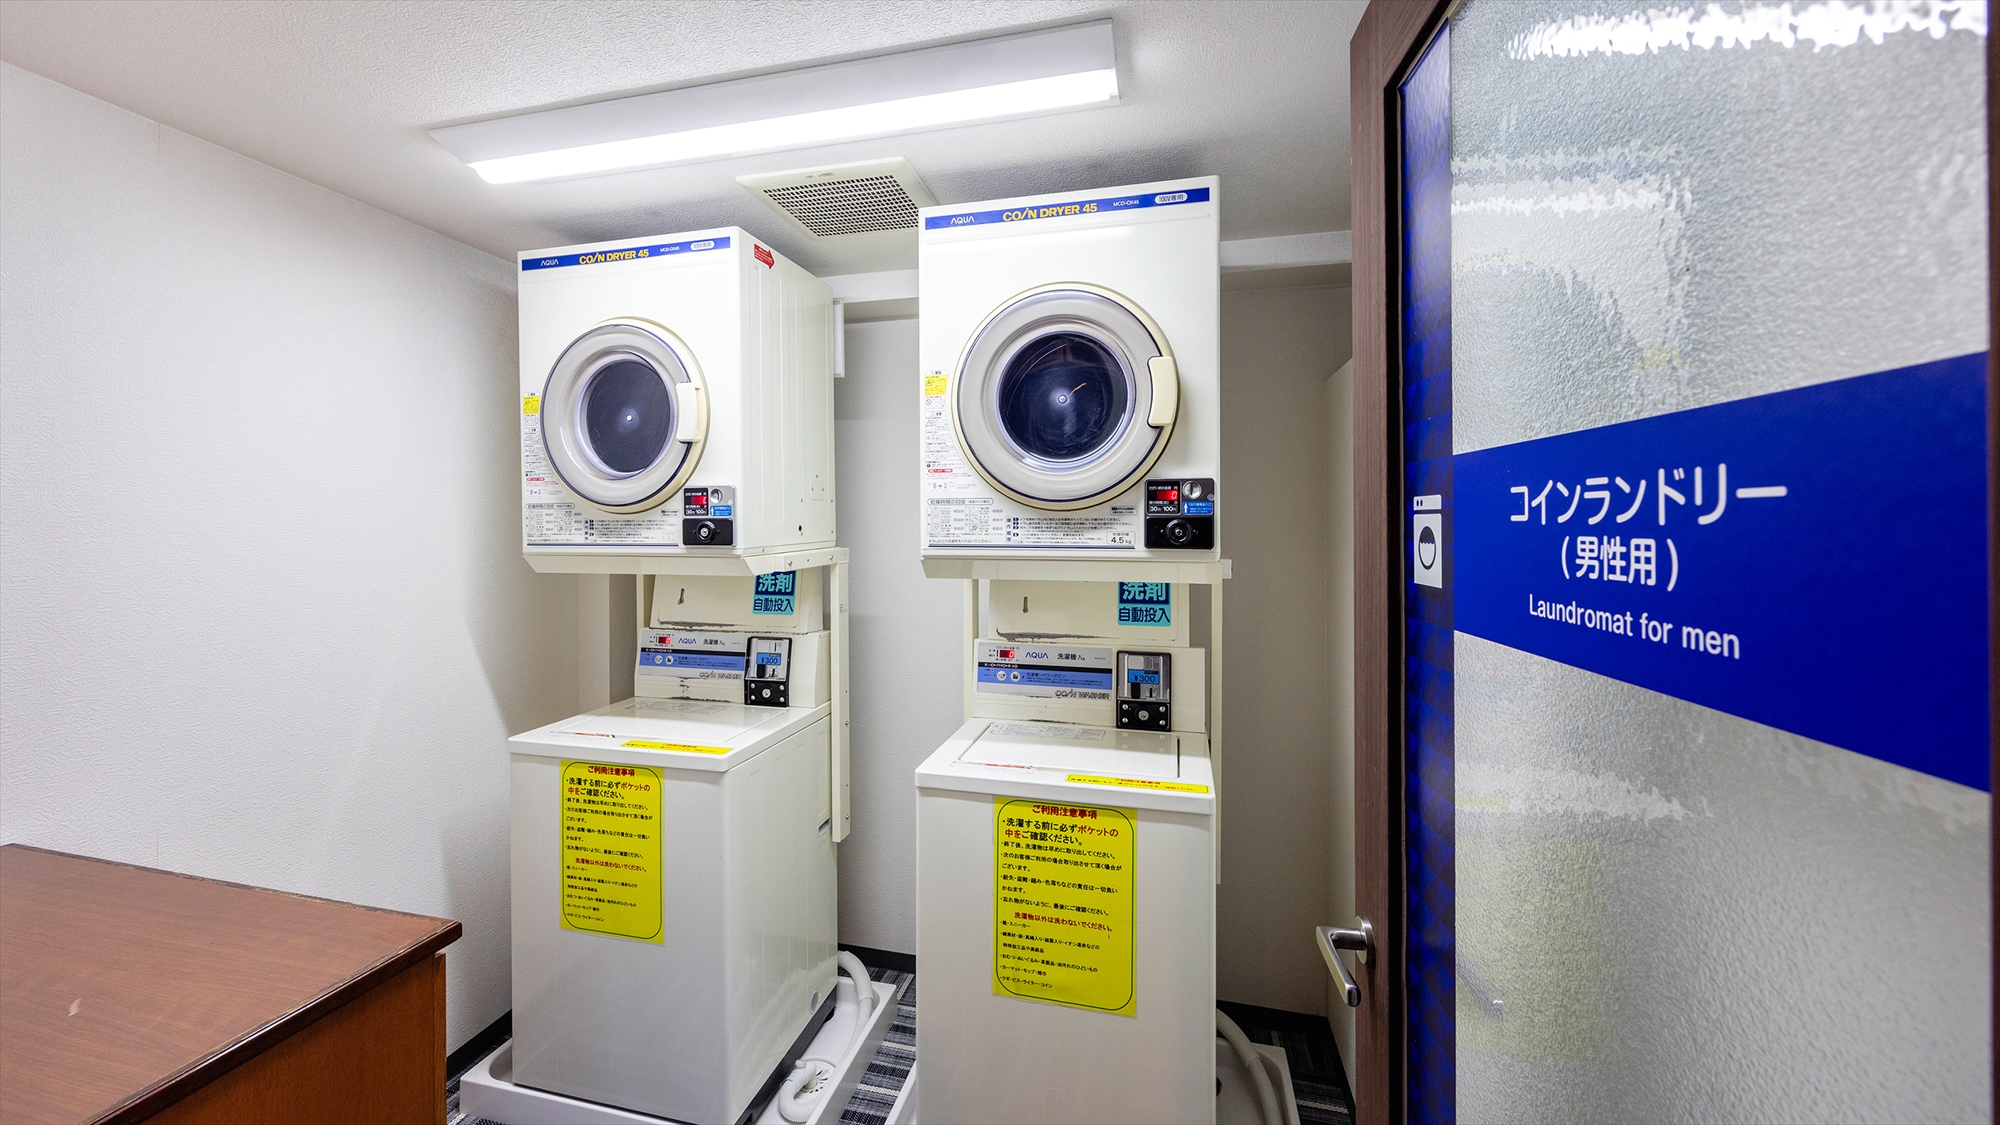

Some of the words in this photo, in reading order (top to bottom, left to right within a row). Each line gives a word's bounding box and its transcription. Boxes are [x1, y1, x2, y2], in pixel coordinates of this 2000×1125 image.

[950, 216, 974, 224] AQUA
[1002, 207, 1037, 222] COIN
[1040, 205, 1080, 218] DRYER
[1082, 203, 1098, 213] 45
[540, 258, 558, 266] AQUA
[578, 251, 605, 265] COIN
[606, 251, 637, 262] DRYER
[638, 250, 649, 258] 45
[1510, 463, 1788, 526] コインランドリー
[1561, 535, 1679, 592] (男性用)
[758, 574, 793, 592] 洗剤
[1122, 582, 1166, 600] 洗剤
[754, 598, 794, 612] 自動投入
[1119, 607, 1170, 623] 自動投入
[1529, 594, 1633, 638] Laundromat
[1640, 613, 1673, 645] for
[1681, 626, 1740, 659] men
[1134, 674, 1155, 682] ¥300
[1078, 690, 1110, 700] WASHER
[588, 766, 635, 777] ご利用注意事項
[568, 787, 624, 799] 中をご確認ください。
[1032, 804, 1098, 819] ご利用注意事項
[1005, 829, 1082, 846] 中をご確認ください。
[1002, 863, 1030, 872] ございます。
[1014, 912, 1112, 932] 洗濯物以外は洗わないでください。
